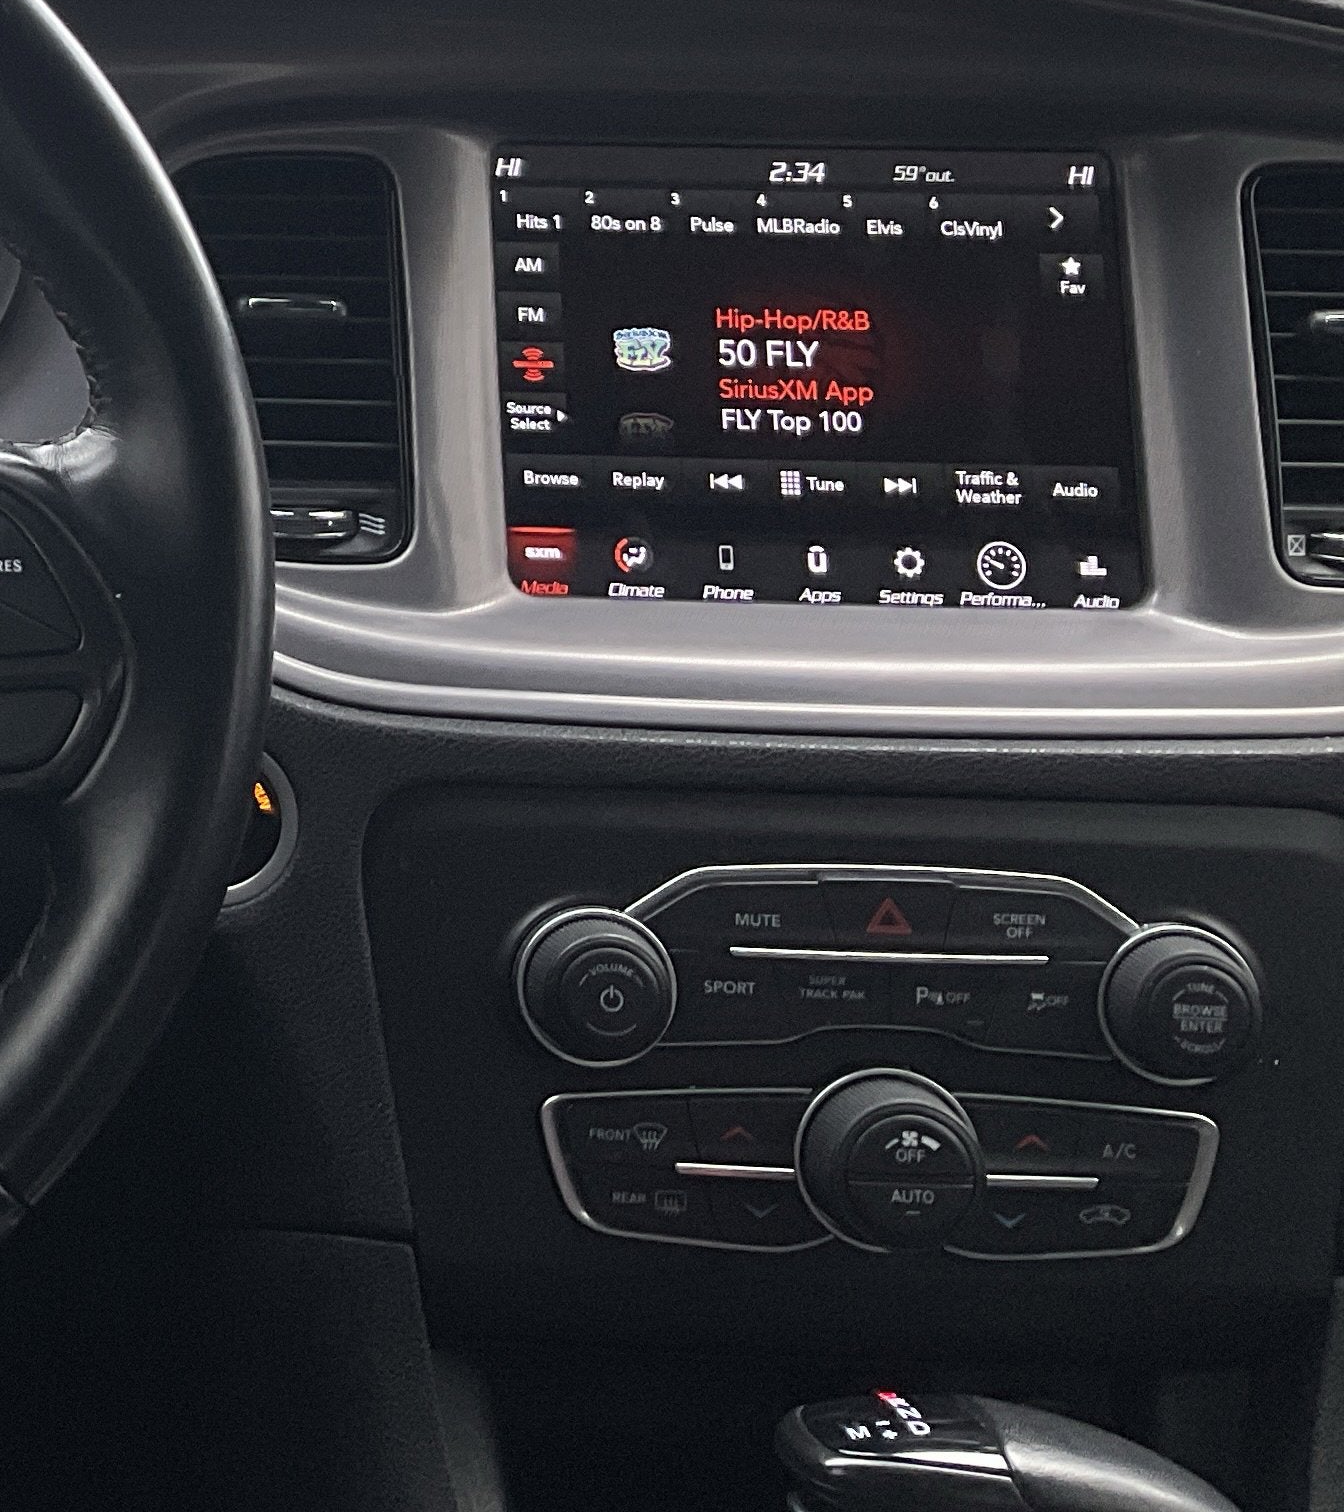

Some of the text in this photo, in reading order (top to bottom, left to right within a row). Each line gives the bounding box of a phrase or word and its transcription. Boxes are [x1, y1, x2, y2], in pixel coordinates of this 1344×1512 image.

[495, 158, 522, 177] HI
[769, 161, 826, 183] 2:34
[1067, 165, 1095, 185] HI
[499, 190, 939, 209] 1 2 3 4 5 6
[516, 214, 561, 229] Hits 1
[591, 215, 662, 231] 80s on 8
[690, 217, 734, 233] Pulse
[757, 218, 841, 235] MLBRadio
[866, 219, 904, 236] Elvis
[940, 221, 1003, 240] ClsVinyl
[515, 258, 543, 273] AM
[1060, 281, 1086, 295] Fav
[517, 307, 545, 322] FM
[715, 307, 871, 334] Hip-Hop/R&B
[718, 339, 819, 368] 50 FLY
[718, 378, 874, 406] SiriusXM App
[506, 401, 552, 415] Source
[510, 417, 551, 431] Select
[721, 408, 862, 436] FLY Top 100
[523, 469, 579, 486] Browse
[612, 471, 665, 490] Replay
[806, 476, 845, 492] Tune
[955, 470, 1019, 486] Traffic &
[955, 489, 1022, 505] Weather
[1052, 483, 1099, 498] Audio
[520, 580, 569, 596] Media
[608, 582, 665, 598] Climate
[703, 584, 755, 600] Phone
[798, 588, 842, 604] Apps
[878, 589, 944, 606] Settings
[1074, 594, 1120, 609] Audio
[734, 912, 781, 928] MUTE
[993, 913, 1046, 926] SCREEN
[1006, 926, 1034, 939] OFF
[704, 978, 756, 996] SPORT
[800, 988, 839, 999] TRACK
[946, 992, 971, 1006] OFF
[1173, 1003, 1227, 1017] BROWSE
[1180, 1019, 1223, 1033] ENTER
[589, 1128, 632, 1141] FRONT
[895, 1148, 926, 1163] OFF
[1103, 1144, 1137, 1161] A/C
[612, 1191, 647, 1204] REAR
[891, 1189, 935, 1205] AUTO
[844, 1420, 932, 1441] M D
